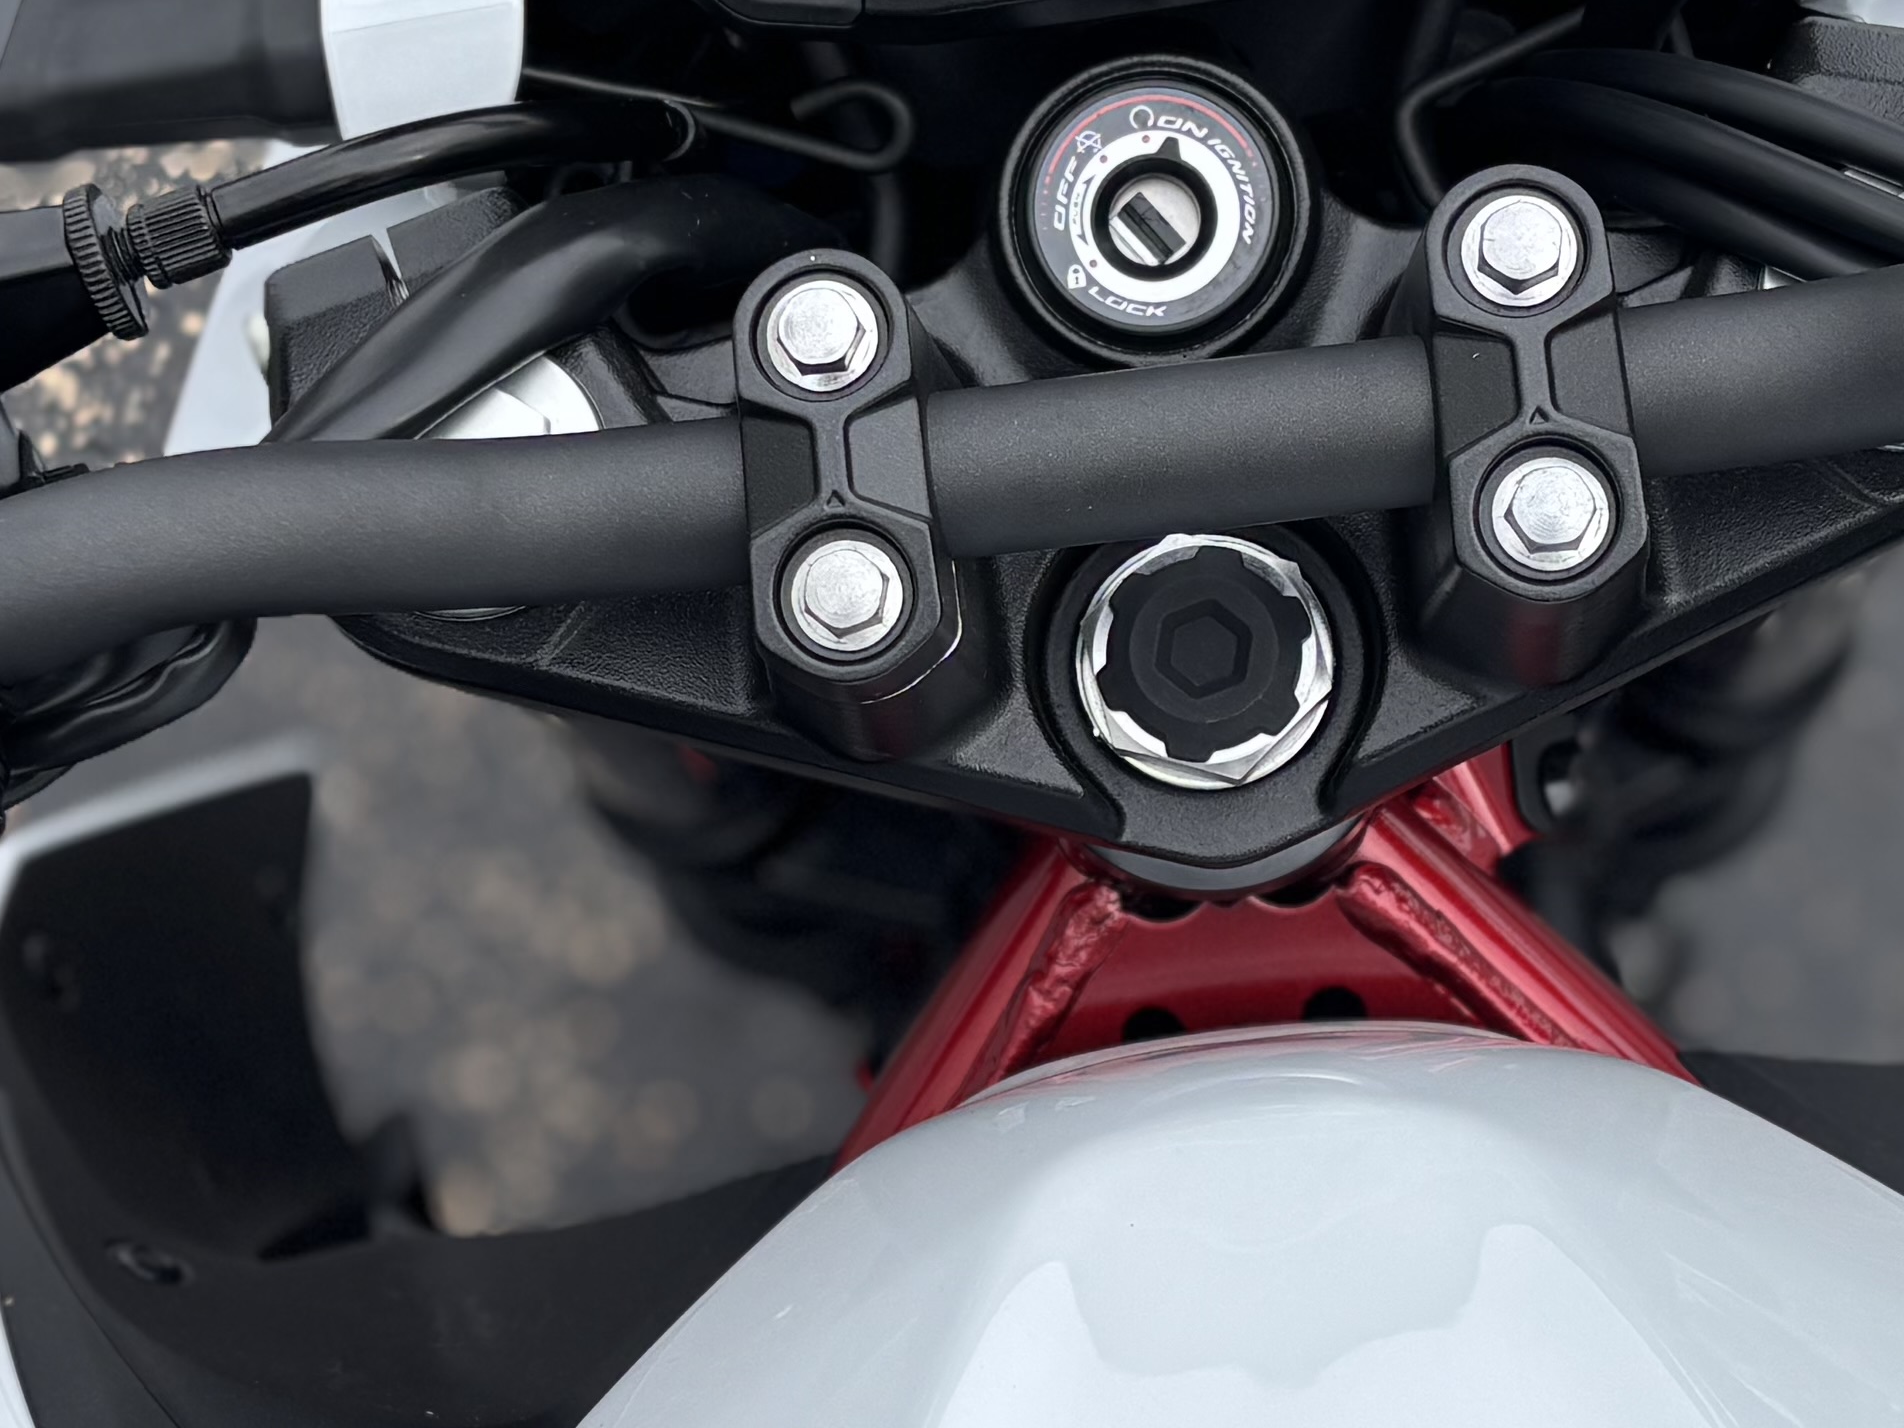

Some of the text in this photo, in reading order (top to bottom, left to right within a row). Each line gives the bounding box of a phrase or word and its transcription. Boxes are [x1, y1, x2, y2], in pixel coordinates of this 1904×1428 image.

[1053, 156, 1077, 232] OFF
[1157, 115, 1257, 245] ON IGNITION
[1087, 285, 1168, 317] LOCK
